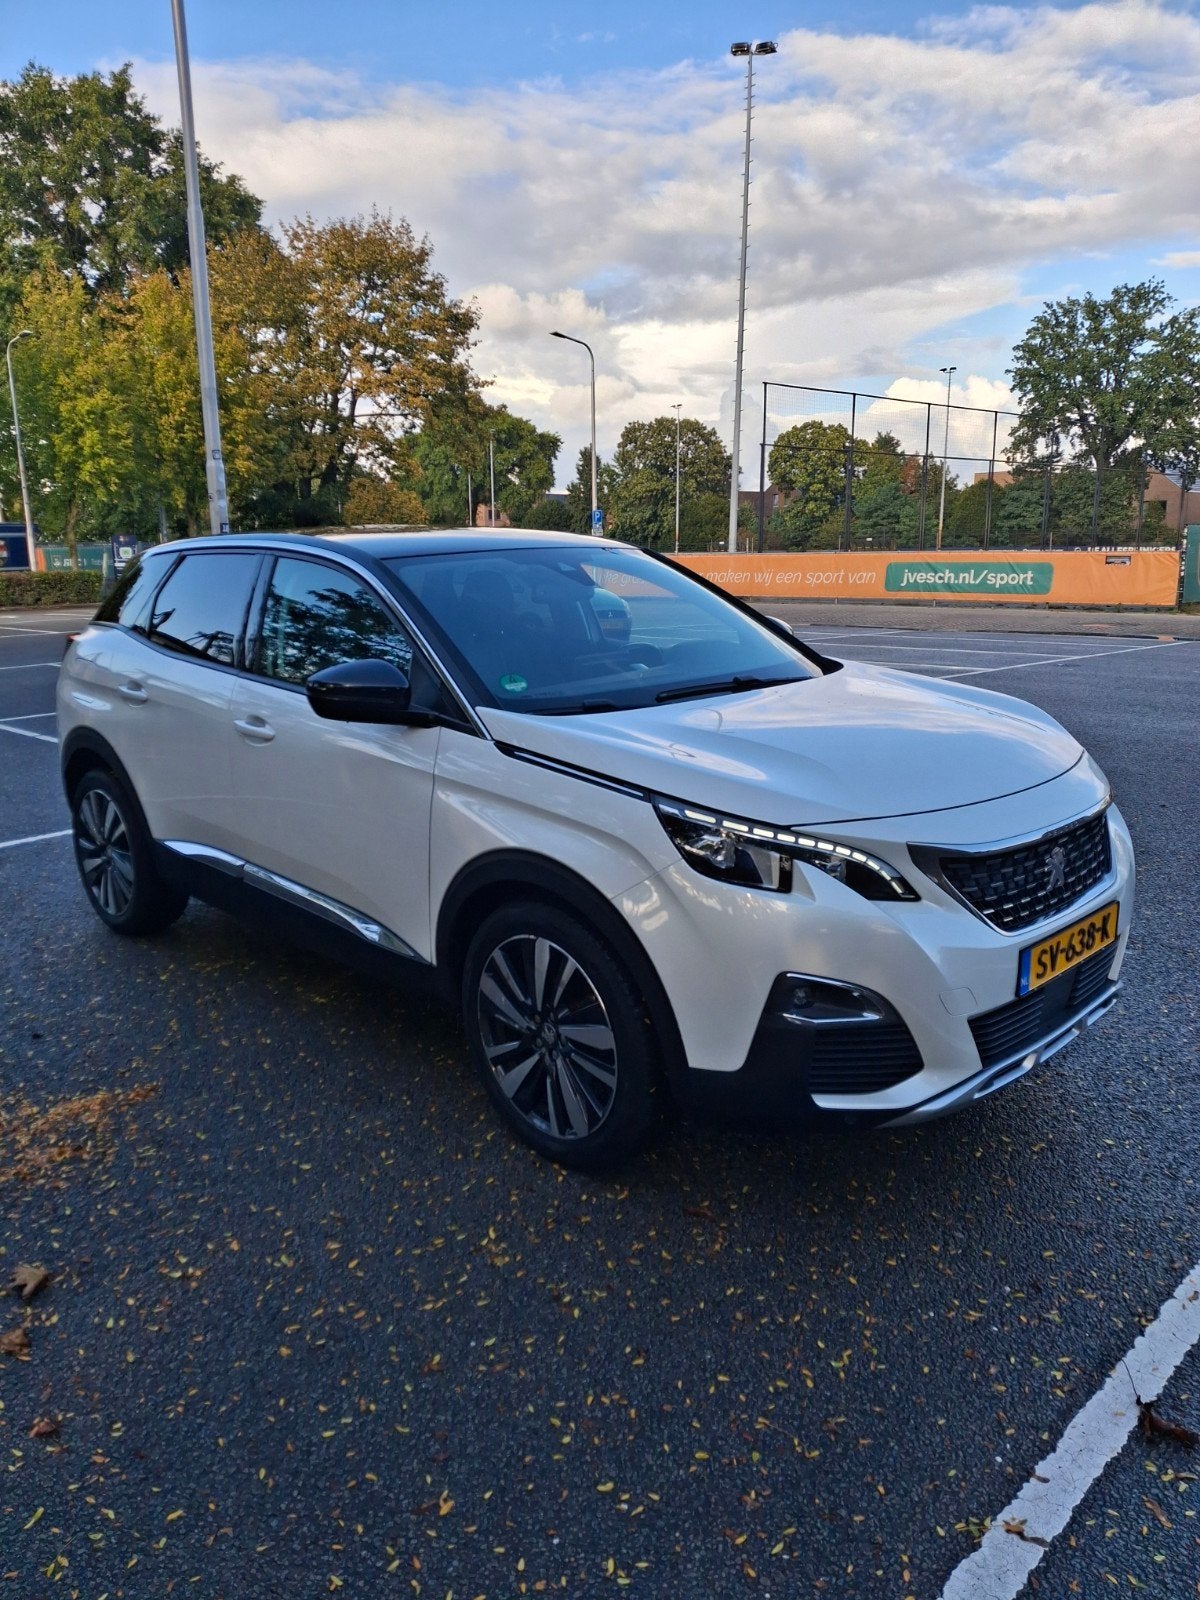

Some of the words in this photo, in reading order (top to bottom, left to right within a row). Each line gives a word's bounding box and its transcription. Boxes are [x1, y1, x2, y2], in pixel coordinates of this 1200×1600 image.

[706, 568, 750, 584] maken
[754, 569, 774, 586] wij
[775, 571, 802, 584] een
[805, 569, 845, 587] sport
[848, 571, 876, 584] van
[900, 568, 1034, 588] jvesch.nl/sport
[1036, 912, 1111, 980] SV-638-K
